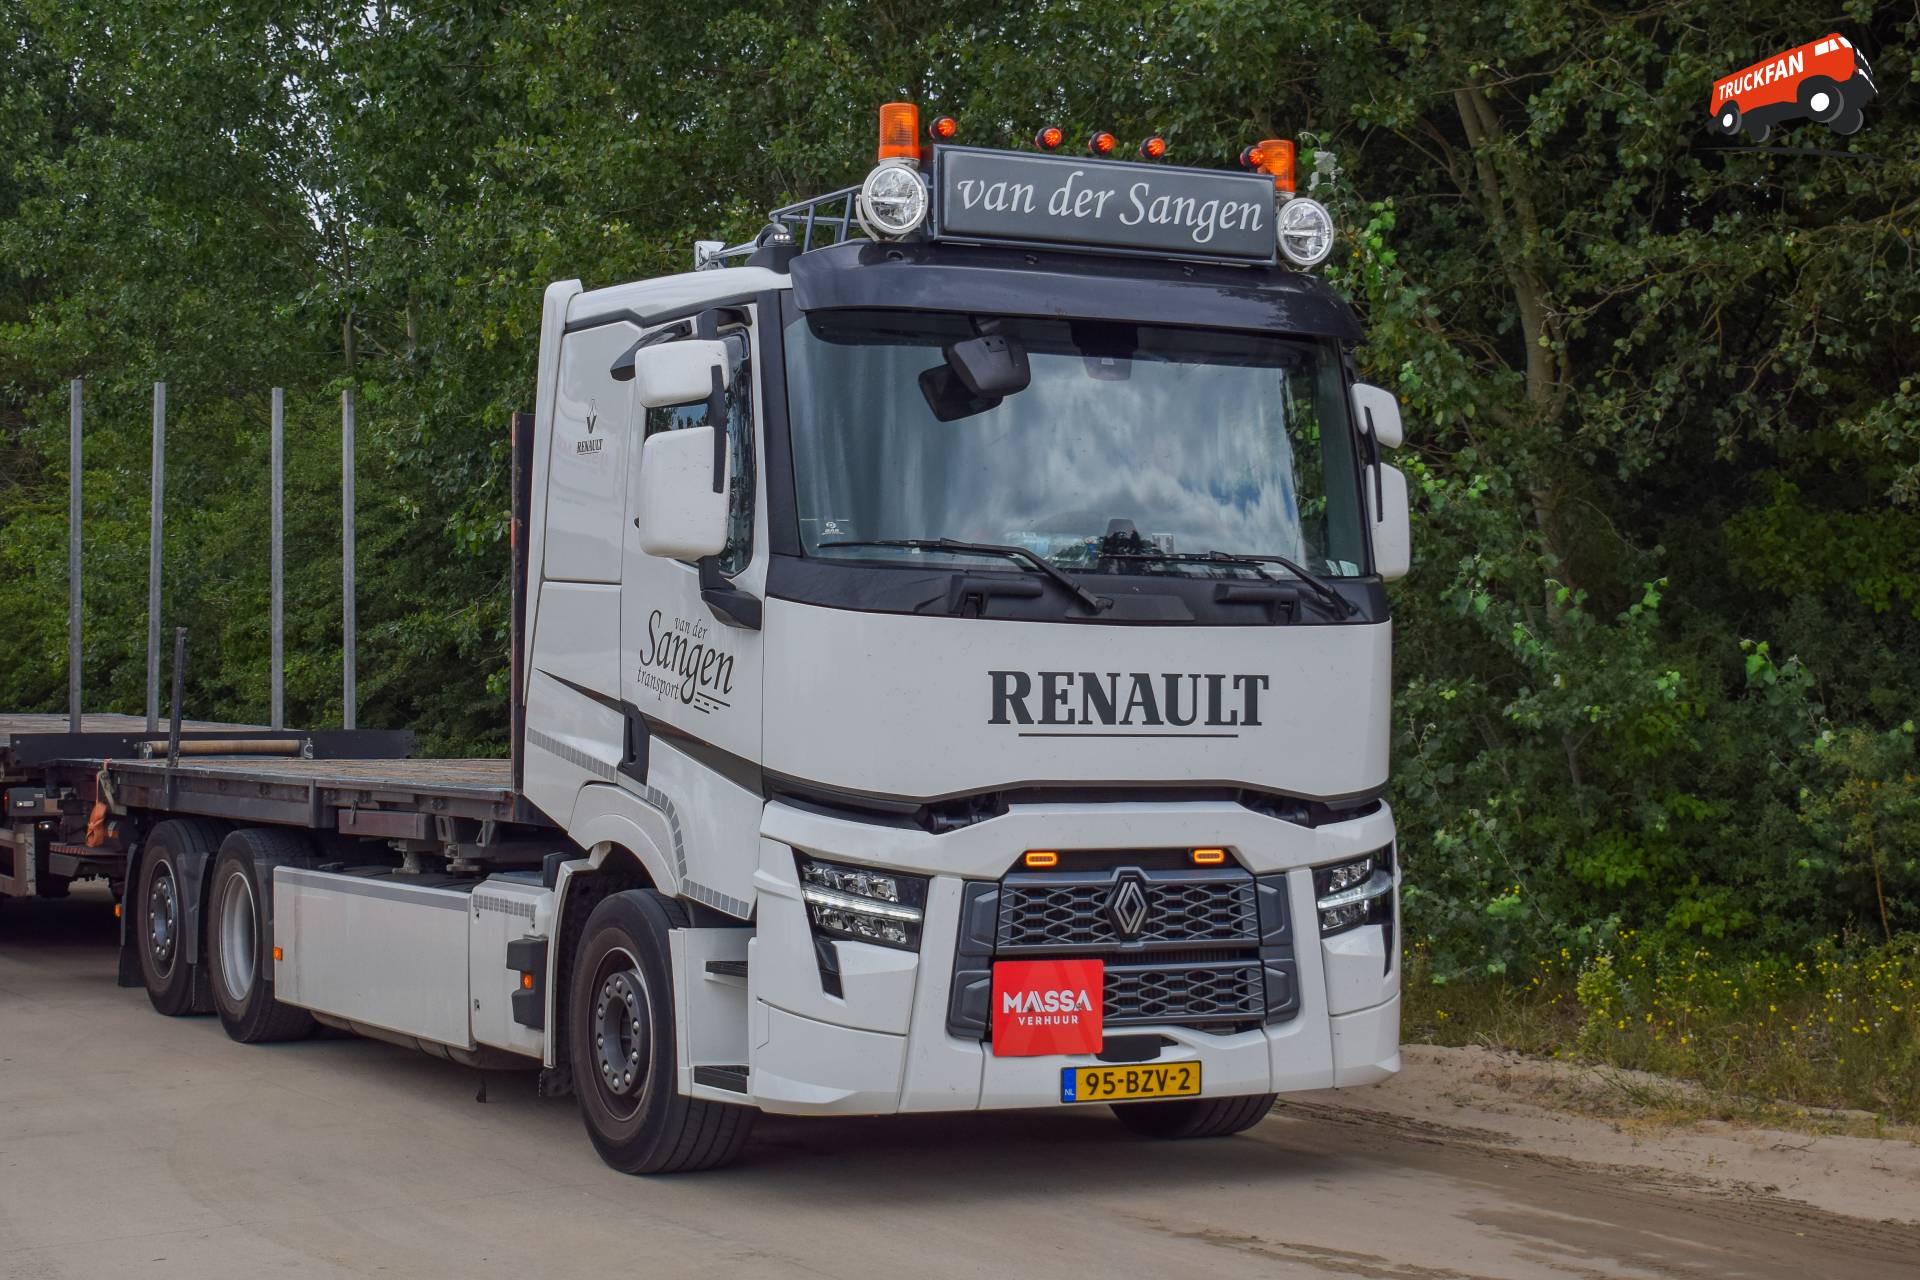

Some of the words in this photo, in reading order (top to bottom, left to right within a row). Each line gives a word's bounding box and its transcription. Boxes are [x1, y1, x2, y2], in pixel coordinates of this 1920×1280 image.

[957, 177, 1036, 214] van
[1048, 171, 1115, 218] der
[1119, 181, 1264, 243] Sangen
[577, 439, 603, 453] RENAULT
[675, 617, 690, 635] van
[692, 618, 708, 640] der
[640, 609, 734, 704] Sangen
[637, 666, 680, 702] transport
[987, 670, 1270, 727] RENAULT
[1003, 989, 1093, 1014] MASSA
[1018, 1015, 1079, 1026] VERHUUR
[1064, 1088, 1075, 1096] NL
[1085, 1068, 1191, 1096] 95-BZV-2
